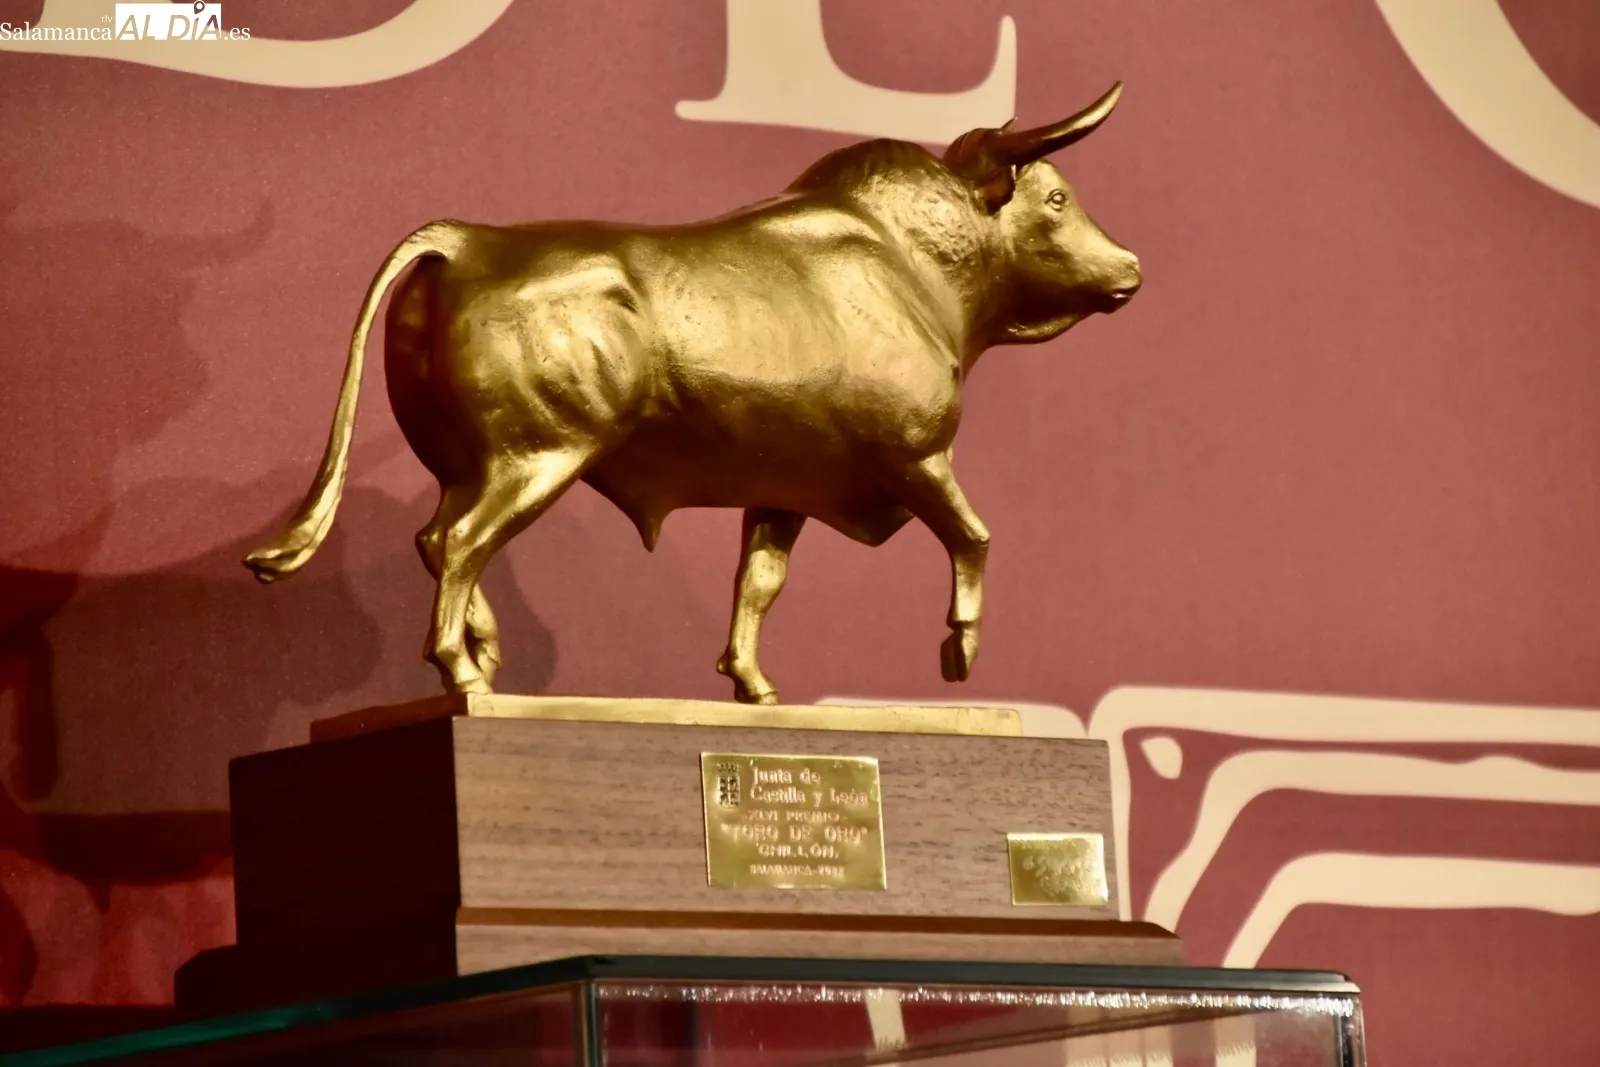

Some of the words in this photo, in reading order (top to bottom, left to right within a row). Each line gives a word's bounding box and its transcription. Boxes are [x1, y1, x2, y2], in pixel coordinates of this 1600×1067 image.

[752, 766, 792, 785] Junta
[800, 767, 821, 785] de
[750, 786, 806, 804] Castilla
[812, 791, 823, 808] y
[829, 787, 868, 805] León
[789, 825, 812, 842] DE
